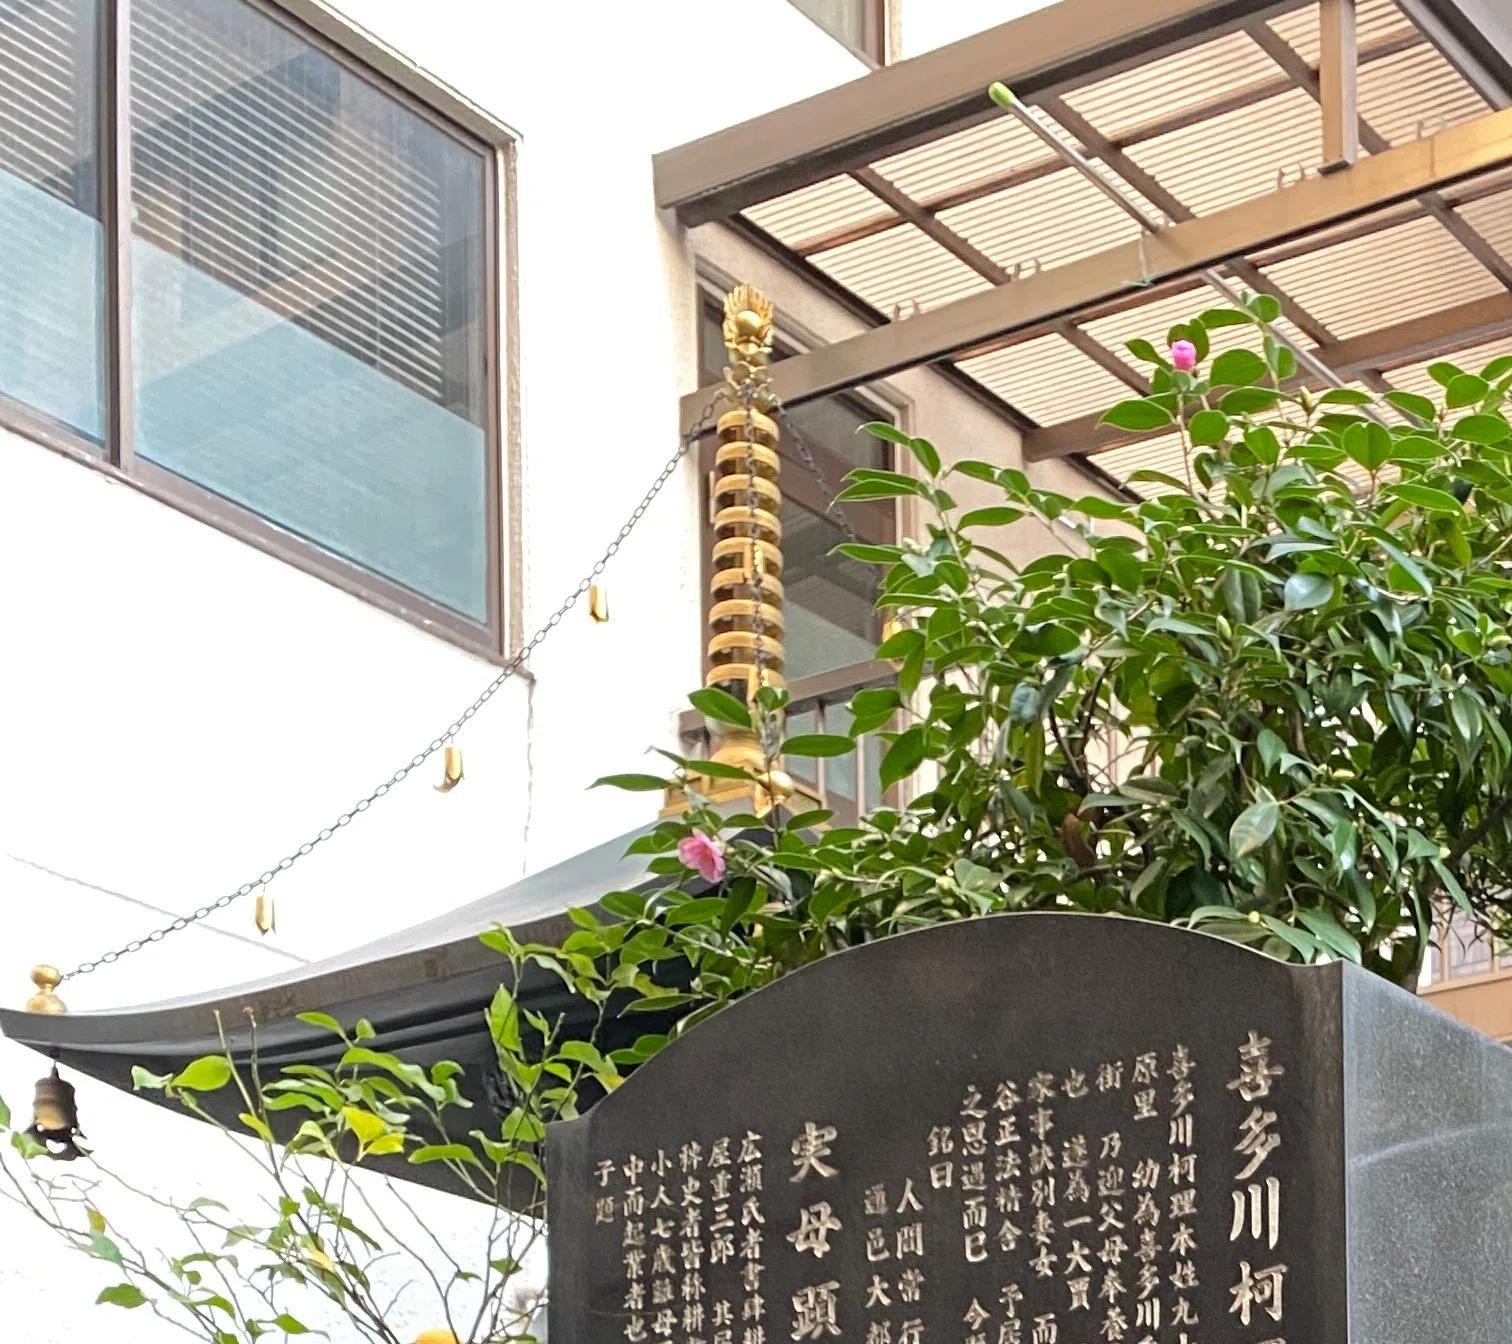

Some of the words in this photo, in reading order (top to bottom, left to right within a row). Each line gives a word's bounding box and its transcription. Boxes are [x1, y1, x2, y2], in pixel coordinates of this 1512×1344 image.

[1060, 1067, 1089, 1099] 也
[1131, 1051, 1159, 1121] 原里
[707, 1136, 736, 1265] 屋重三郎
